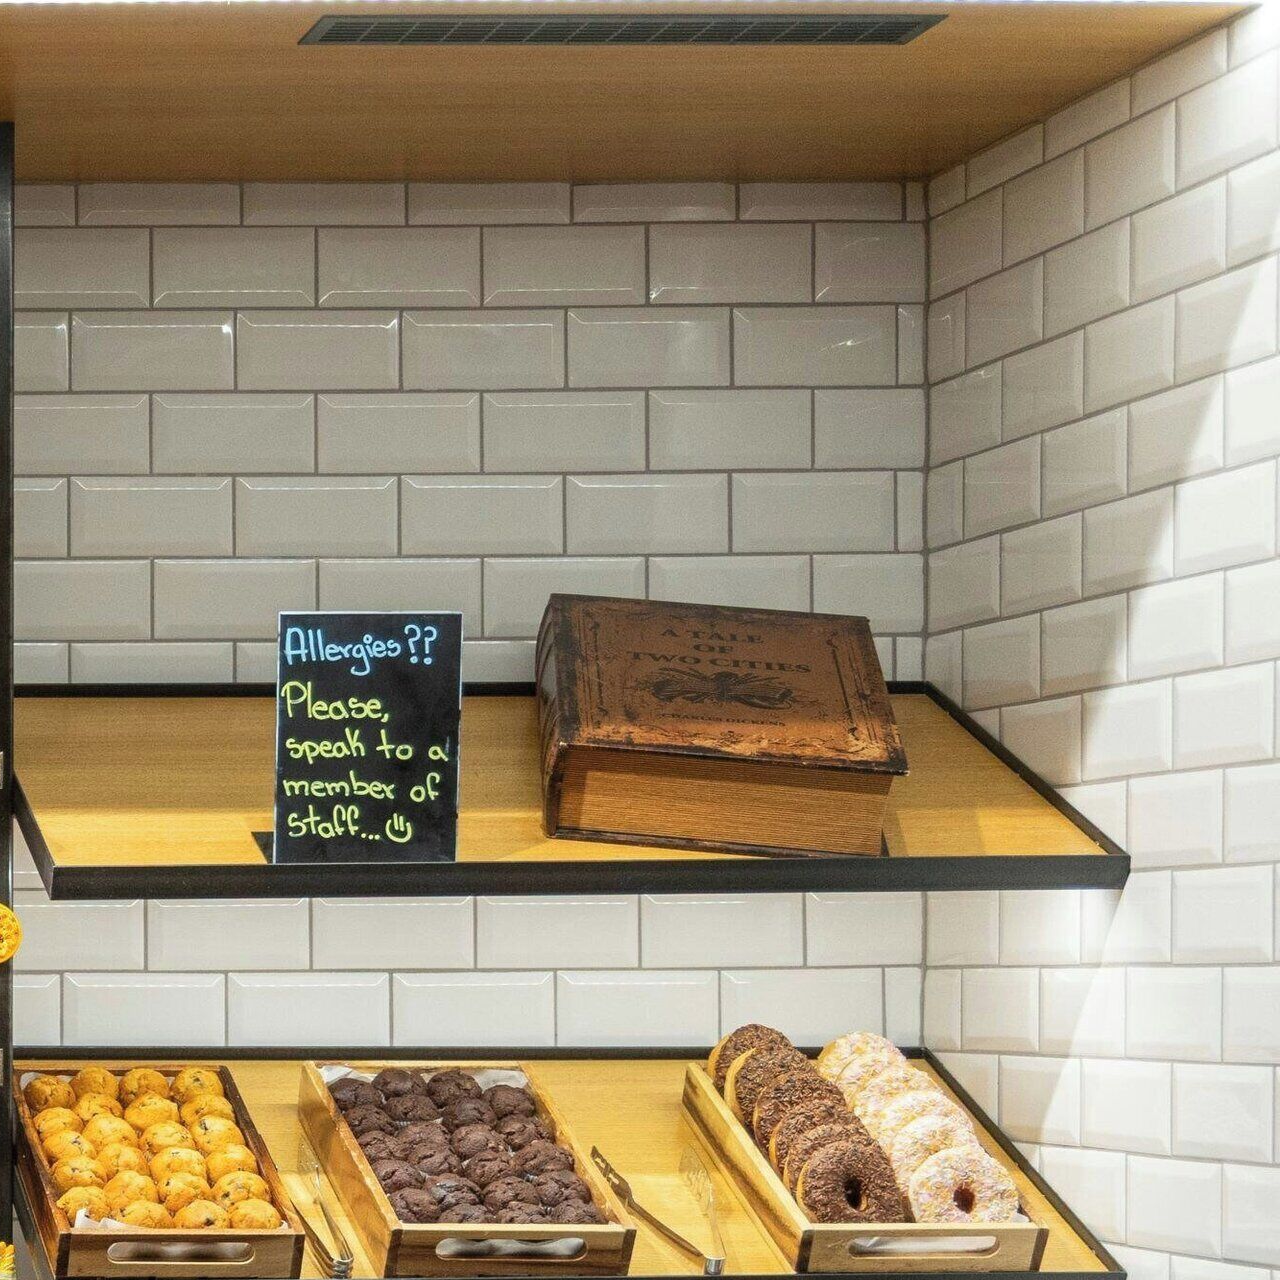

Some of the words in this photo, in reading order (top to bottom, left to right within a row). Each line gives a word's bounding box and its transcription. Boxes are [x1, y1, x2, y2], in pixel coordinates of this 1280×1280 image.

[661, 627, 679, 637] A
[687, 629, 764, 644] TALE
[693, 643, 734, 654] OF
[627, 651, 702, 665] TWO
[709, 658, 812, 674] CITIES
[281, 680, 389, 723] Please,
[725, 716, 786, 728] DICKENS
[285, 727, 366, 765] speak
[376, 729, 414, 759] to
[428, 745, 449, 762] a
[283, 770, 395, 800] member
[409, 772, 441, 803] of
